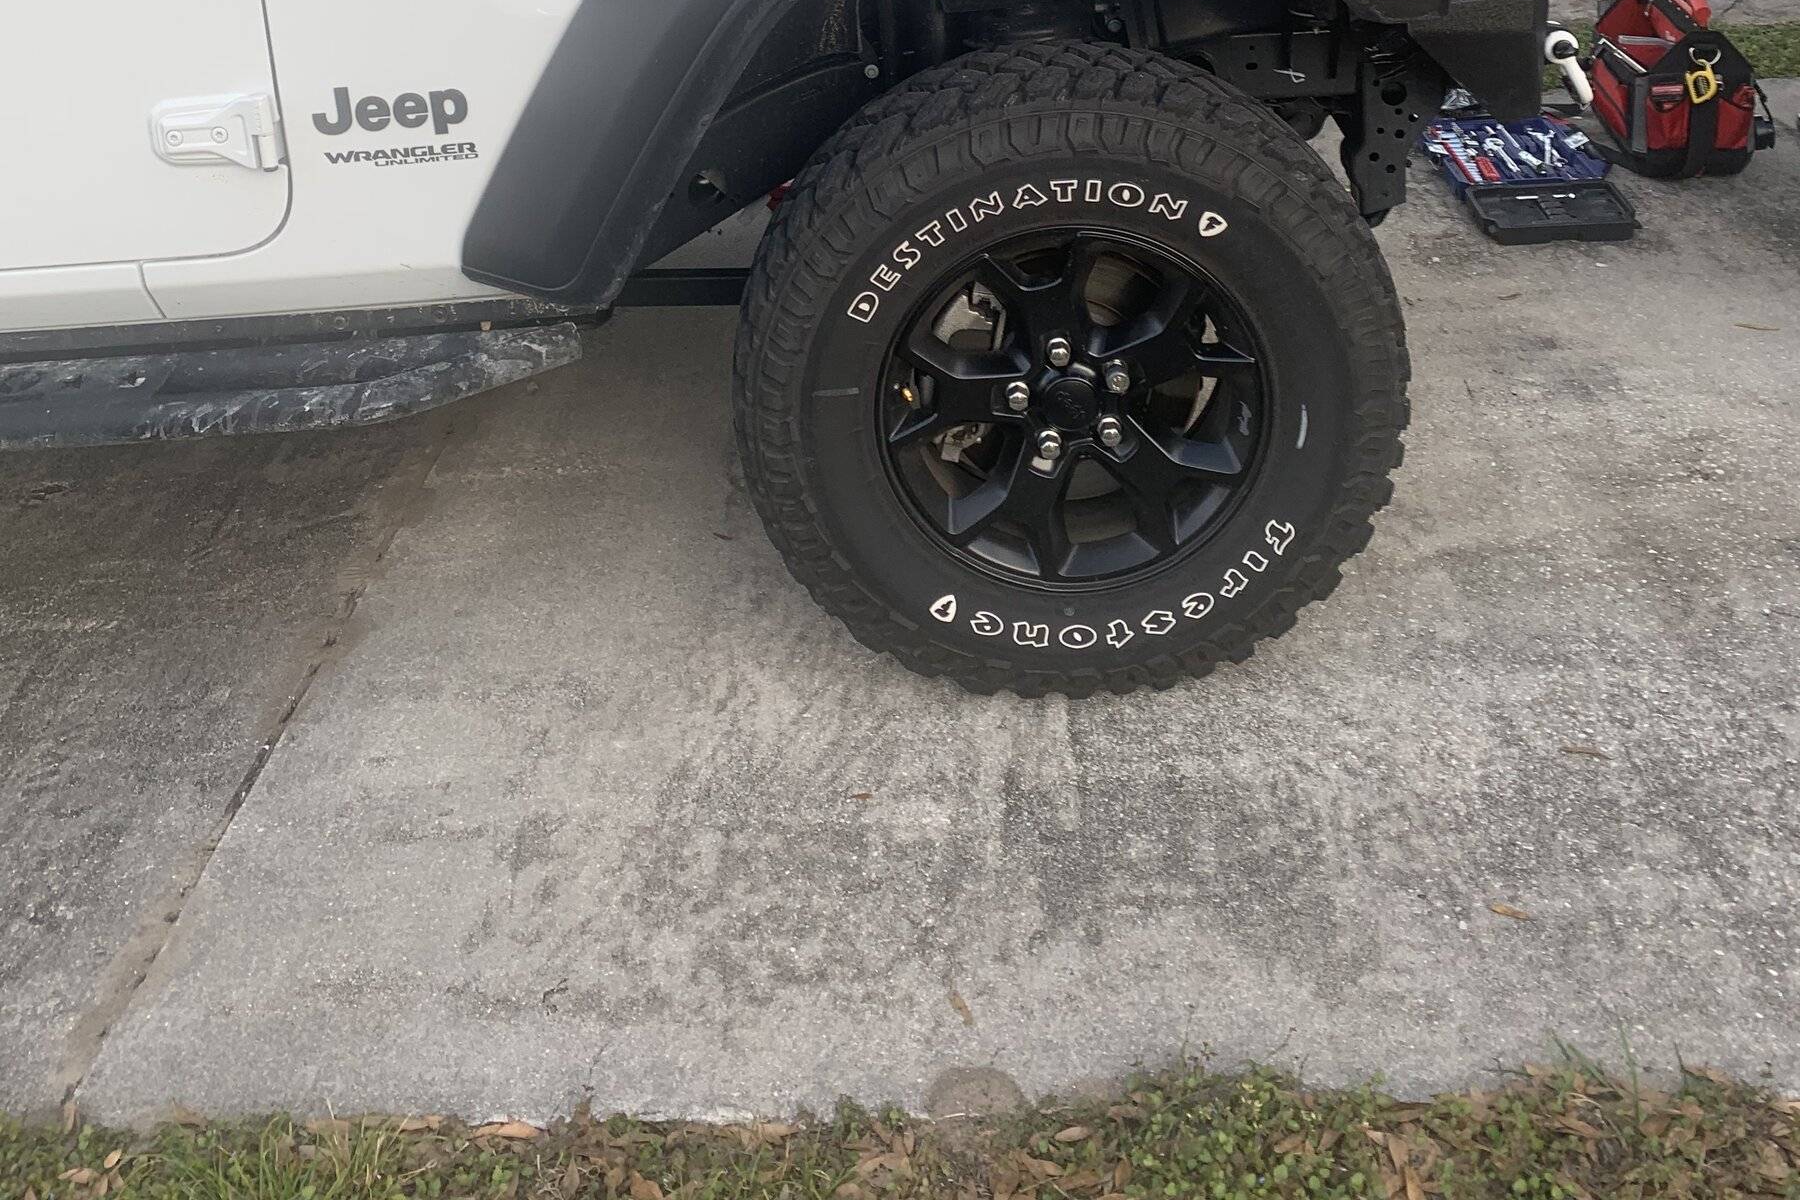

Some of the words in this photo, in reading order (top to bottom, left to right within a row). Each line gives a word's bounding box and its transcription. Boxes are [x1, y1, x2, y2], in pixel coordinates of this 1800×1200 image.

[312, 86, 468, 135] Jeep
[324, 142, 477, 164] WRANGLER
[375, 153, 479, 167] UNLIMITED
[847, 180, 1188, 323] DESTINATION
